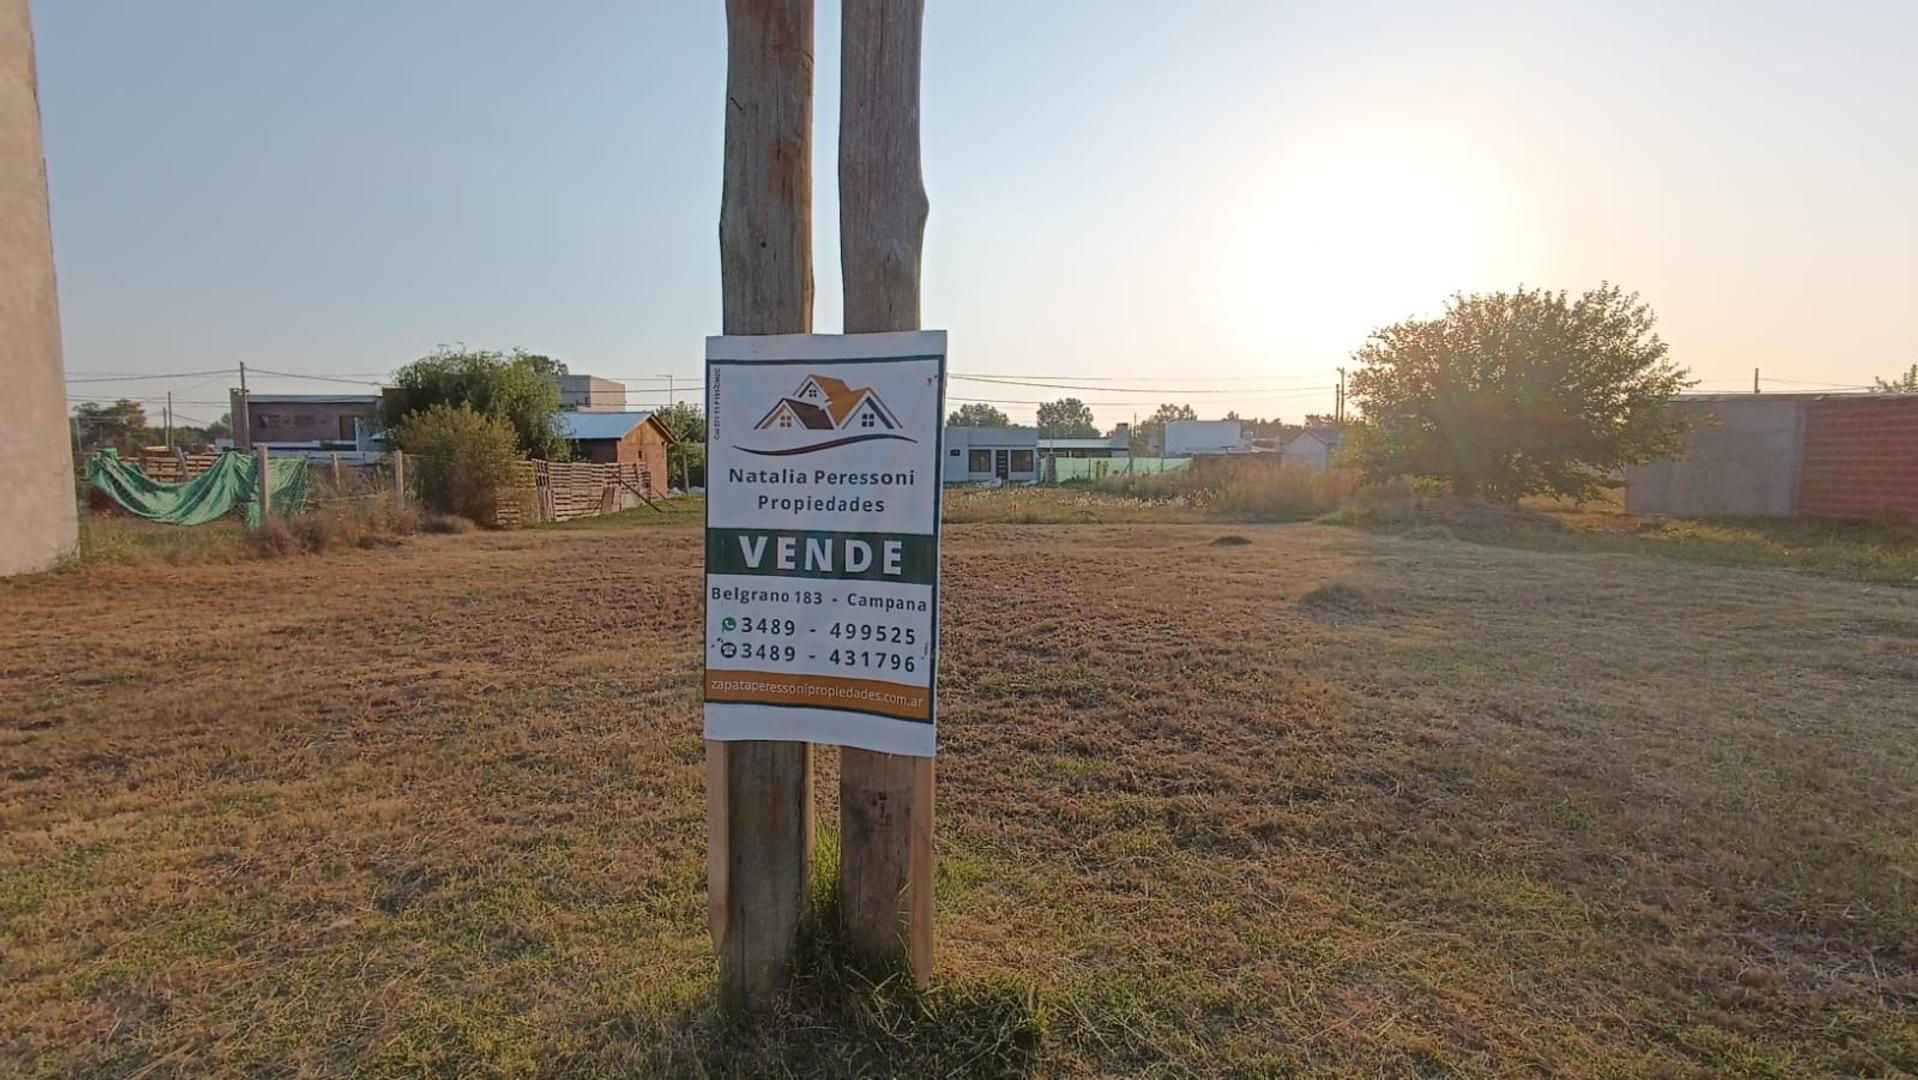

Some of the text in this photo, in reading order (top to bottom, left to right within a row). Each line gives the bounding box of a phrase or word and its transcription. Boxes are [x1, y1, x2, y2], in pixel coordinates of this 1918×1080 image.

[729, 468, 915, 487] Natalia Peressoni
[758, 495, 885, 514] Propiedades
[738, 535, 904, 576] VENDE
[711, 587, 789, 604] Belgrano
[794, 591, 823, 605] 183
[847, 592, 927, 612] Campana
[741, 617, 796, 636] 3489
[829, 622, 916, 645] 499525
[741, 643, 796, 662] 3489
[829, 648, 916, 673] 431796
[711, 680, 925, 707] zapataperessonipropiedades.com.ar
